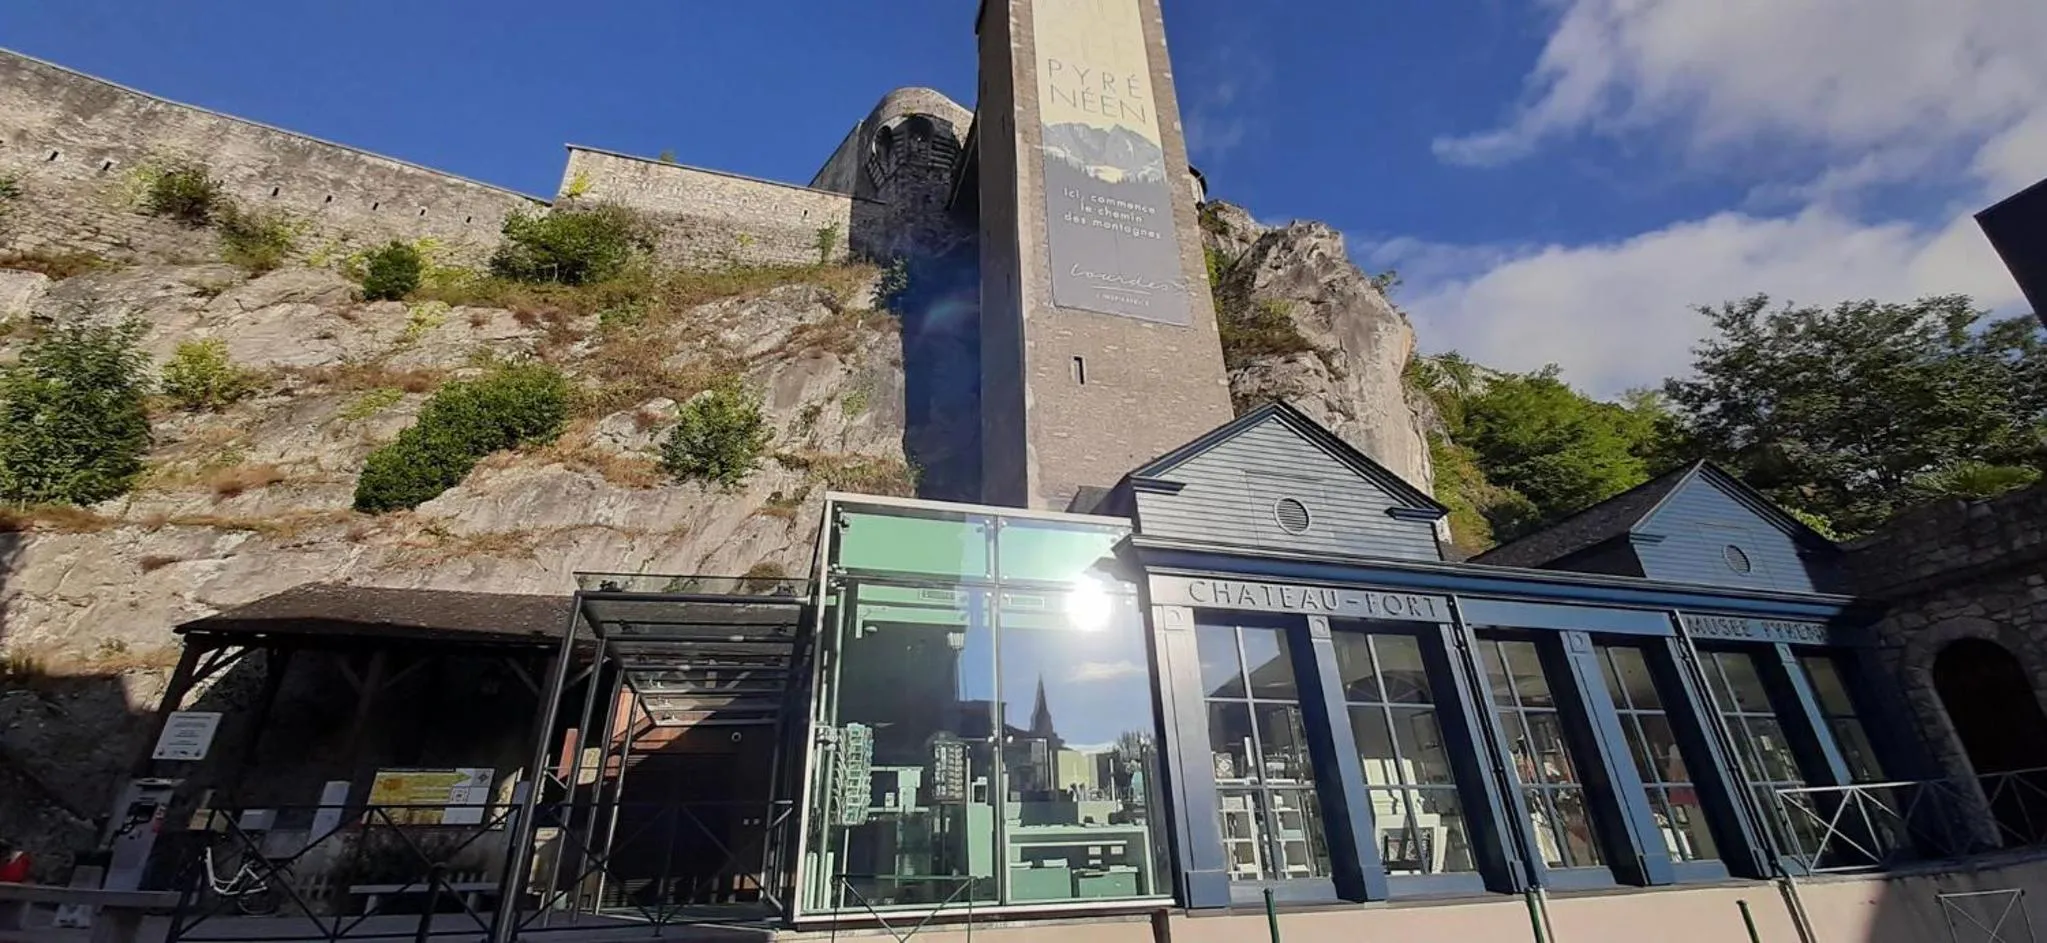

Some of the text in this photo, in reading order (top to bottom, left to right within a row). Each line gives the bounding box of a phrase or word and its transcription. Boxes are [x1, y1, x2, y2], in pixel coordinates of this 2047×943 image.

[1047, 58, 1143, 99] PYRÉ
[1050, 84, 1147, 125] NÉEN
[1080, 200, 1143, 224] le chemin
[1090, 195, 1156, 214] commence
[1064, 211, 1160, 240] des montagnes
